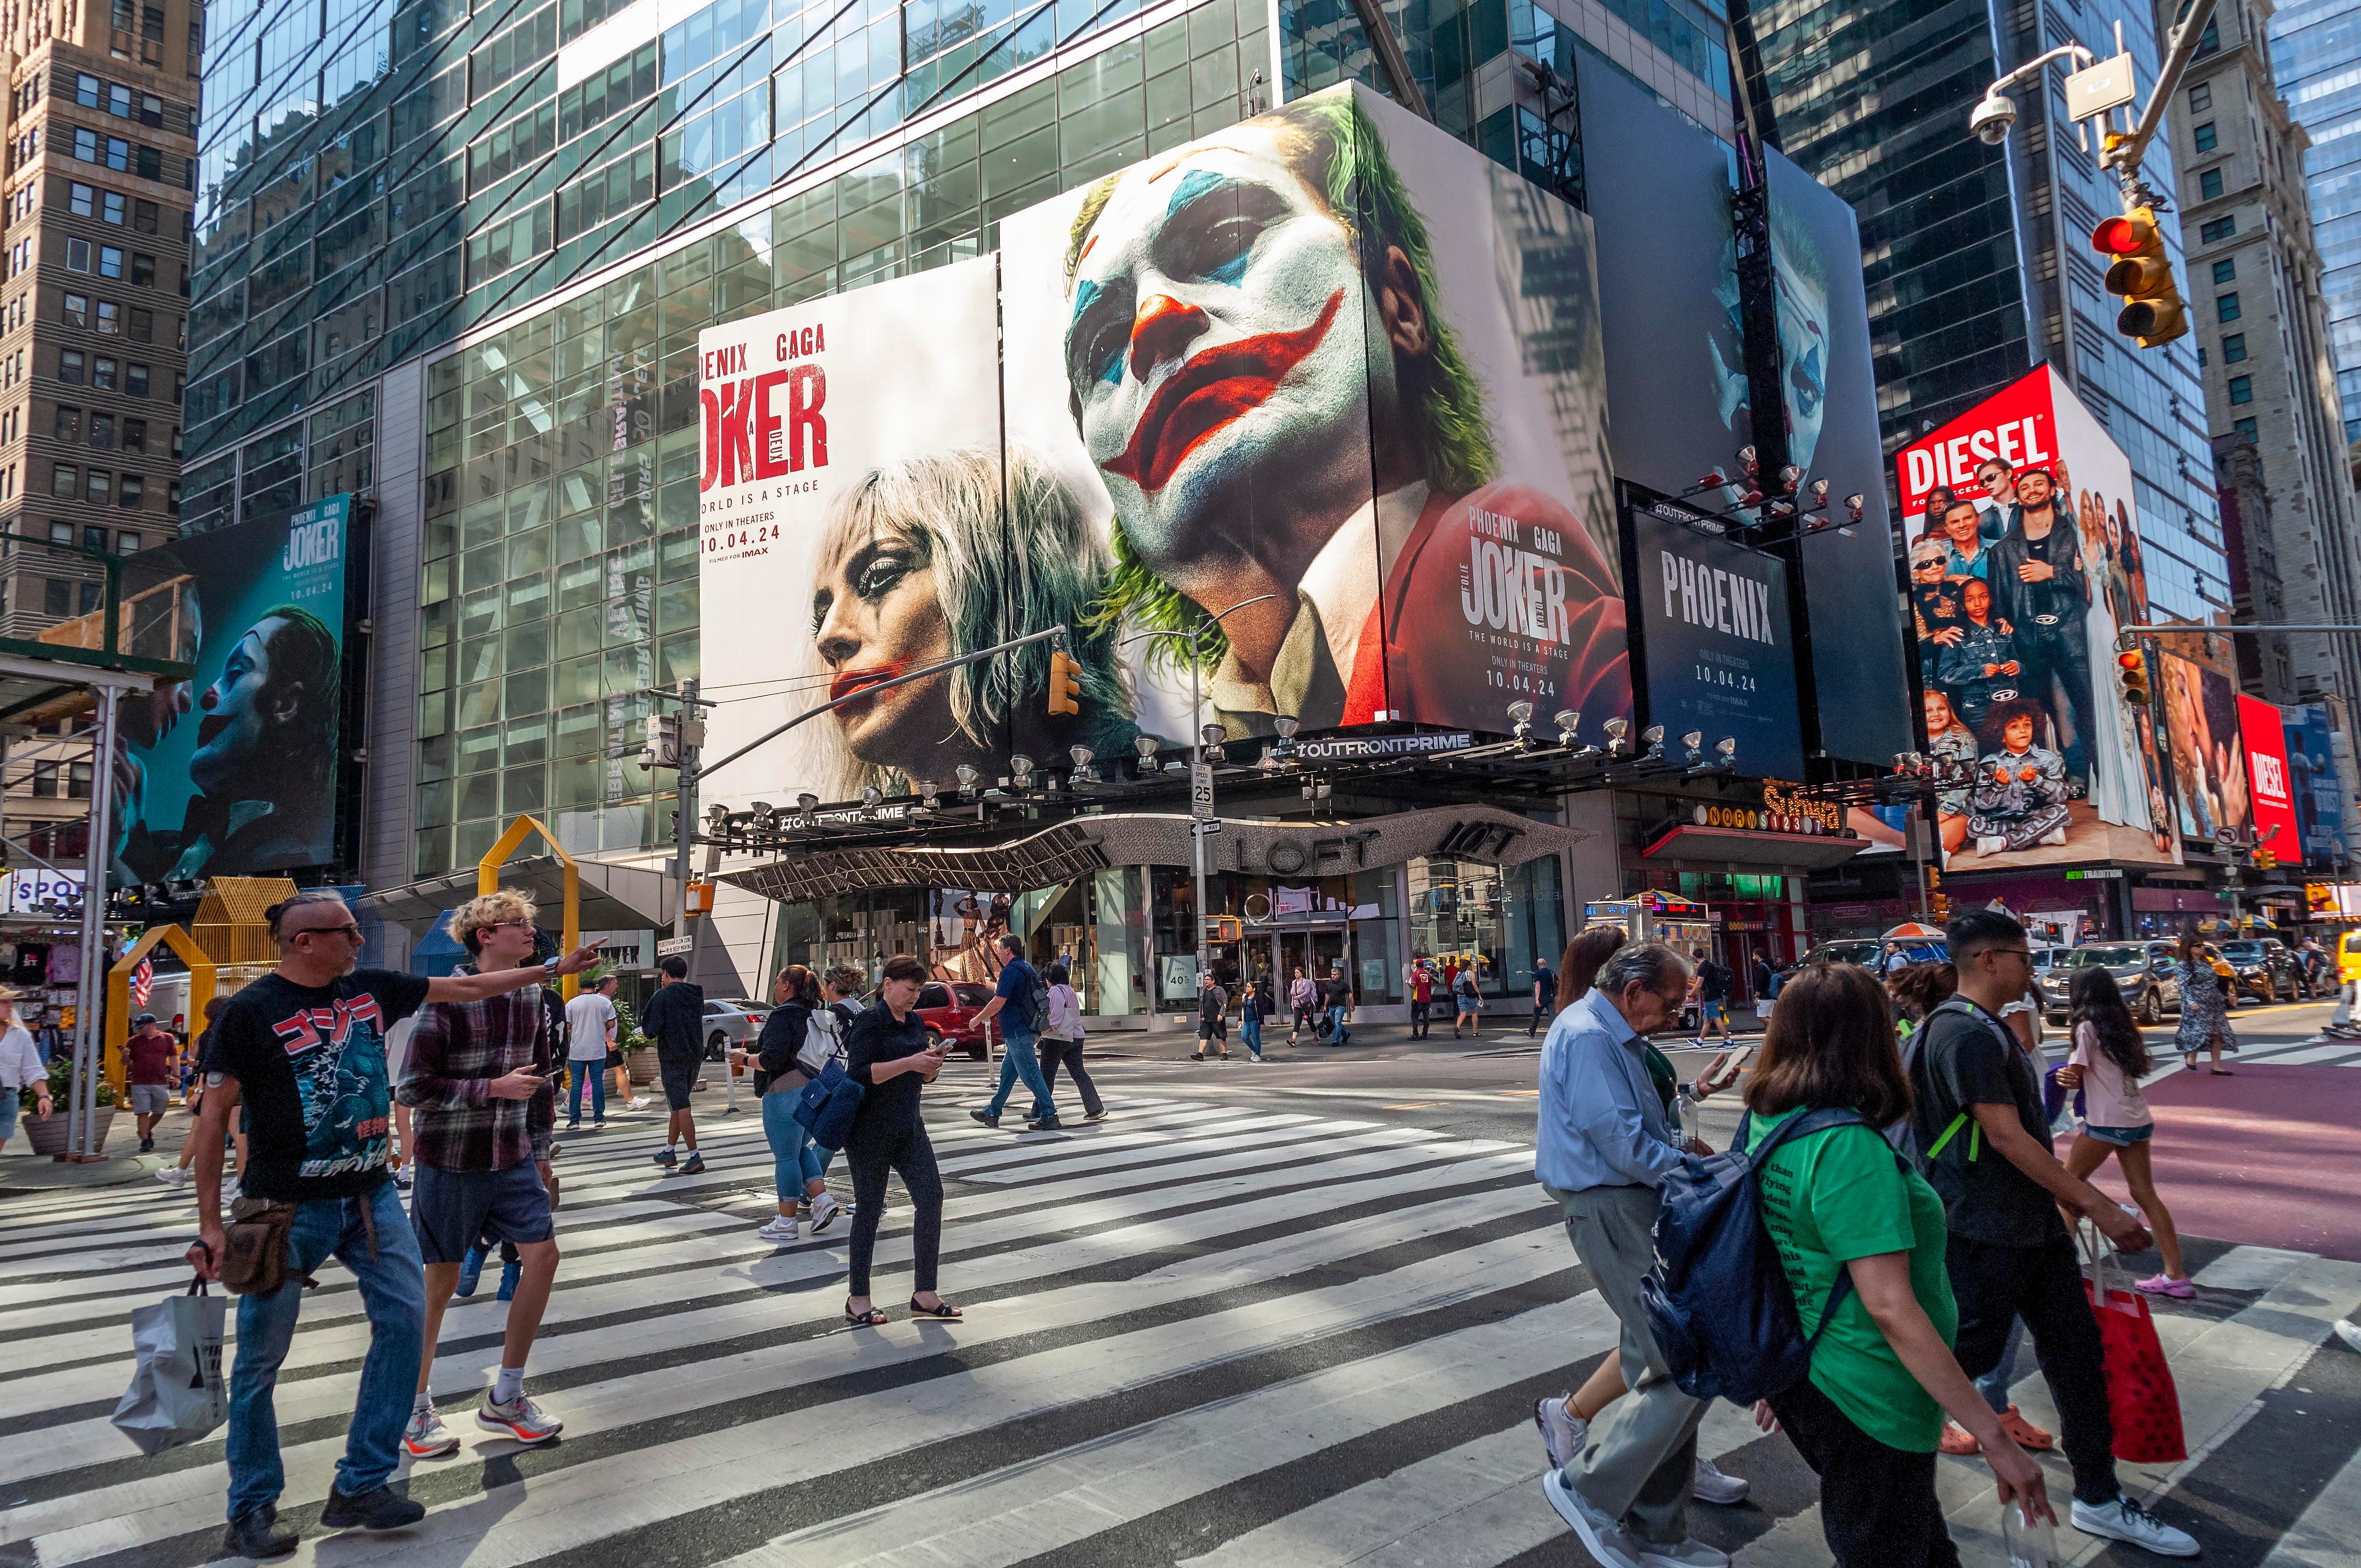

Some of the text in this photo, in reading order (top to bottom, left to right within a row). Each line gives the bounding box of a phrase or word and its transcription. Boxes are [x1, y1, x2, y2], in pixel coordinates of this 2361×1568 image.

[777, 324, 825, 362] GAGA
[770, 431, 782, 461] DEUX
[1907, 416, 2049, 496] DIESEL
[701, 480, 818, 514] ORLD IS A STAGE
[291, 502, 340, 527] PHOENIX GAGA
[705, 511, 774, 533] ONLY IN THEATERS
[283, 518, 339, 571] JOKER
[701, 525, 780, 553] 10.04.24
[1469, 506, 1563, 557] PHOENIX GAGA
[709, 556, 728, 564] FILMED
[742, 547, 769, 558] IMAX
[1460, 563, 1468, 591] FOLIE
[1461, 536, 1570, 645] JOKER
[291, 582, 333, 601] 10.04.24
[1661, 550, 1774, 645] PHOENIX
[1536, 601, 1545, 628] DEUX
[1469, 630, 1568, 660] THE WORLD IS A STAGE
[1492, 655, 1548, 676] ONLY IN THEATERS
[1722, 654, 1749, 669] THEATERS
[1487, 670, 1554, 696] 10.04.24
[1696, 665, 1755, 692] 10.04.24
[2251, 752, 2287, 799] DIESEL
[1195, 786, 1211, 802] 25
[1712, 810, 1820, 831] N Q R W S 1 2 3 7
[1236, 830, 1381, 877] LOFT
[2084, 869, 2123, 879] TRADITION
[659, 938, 675, 948] PEDESTRIAN
[273, 992, 384, 1056] ゴジラ
